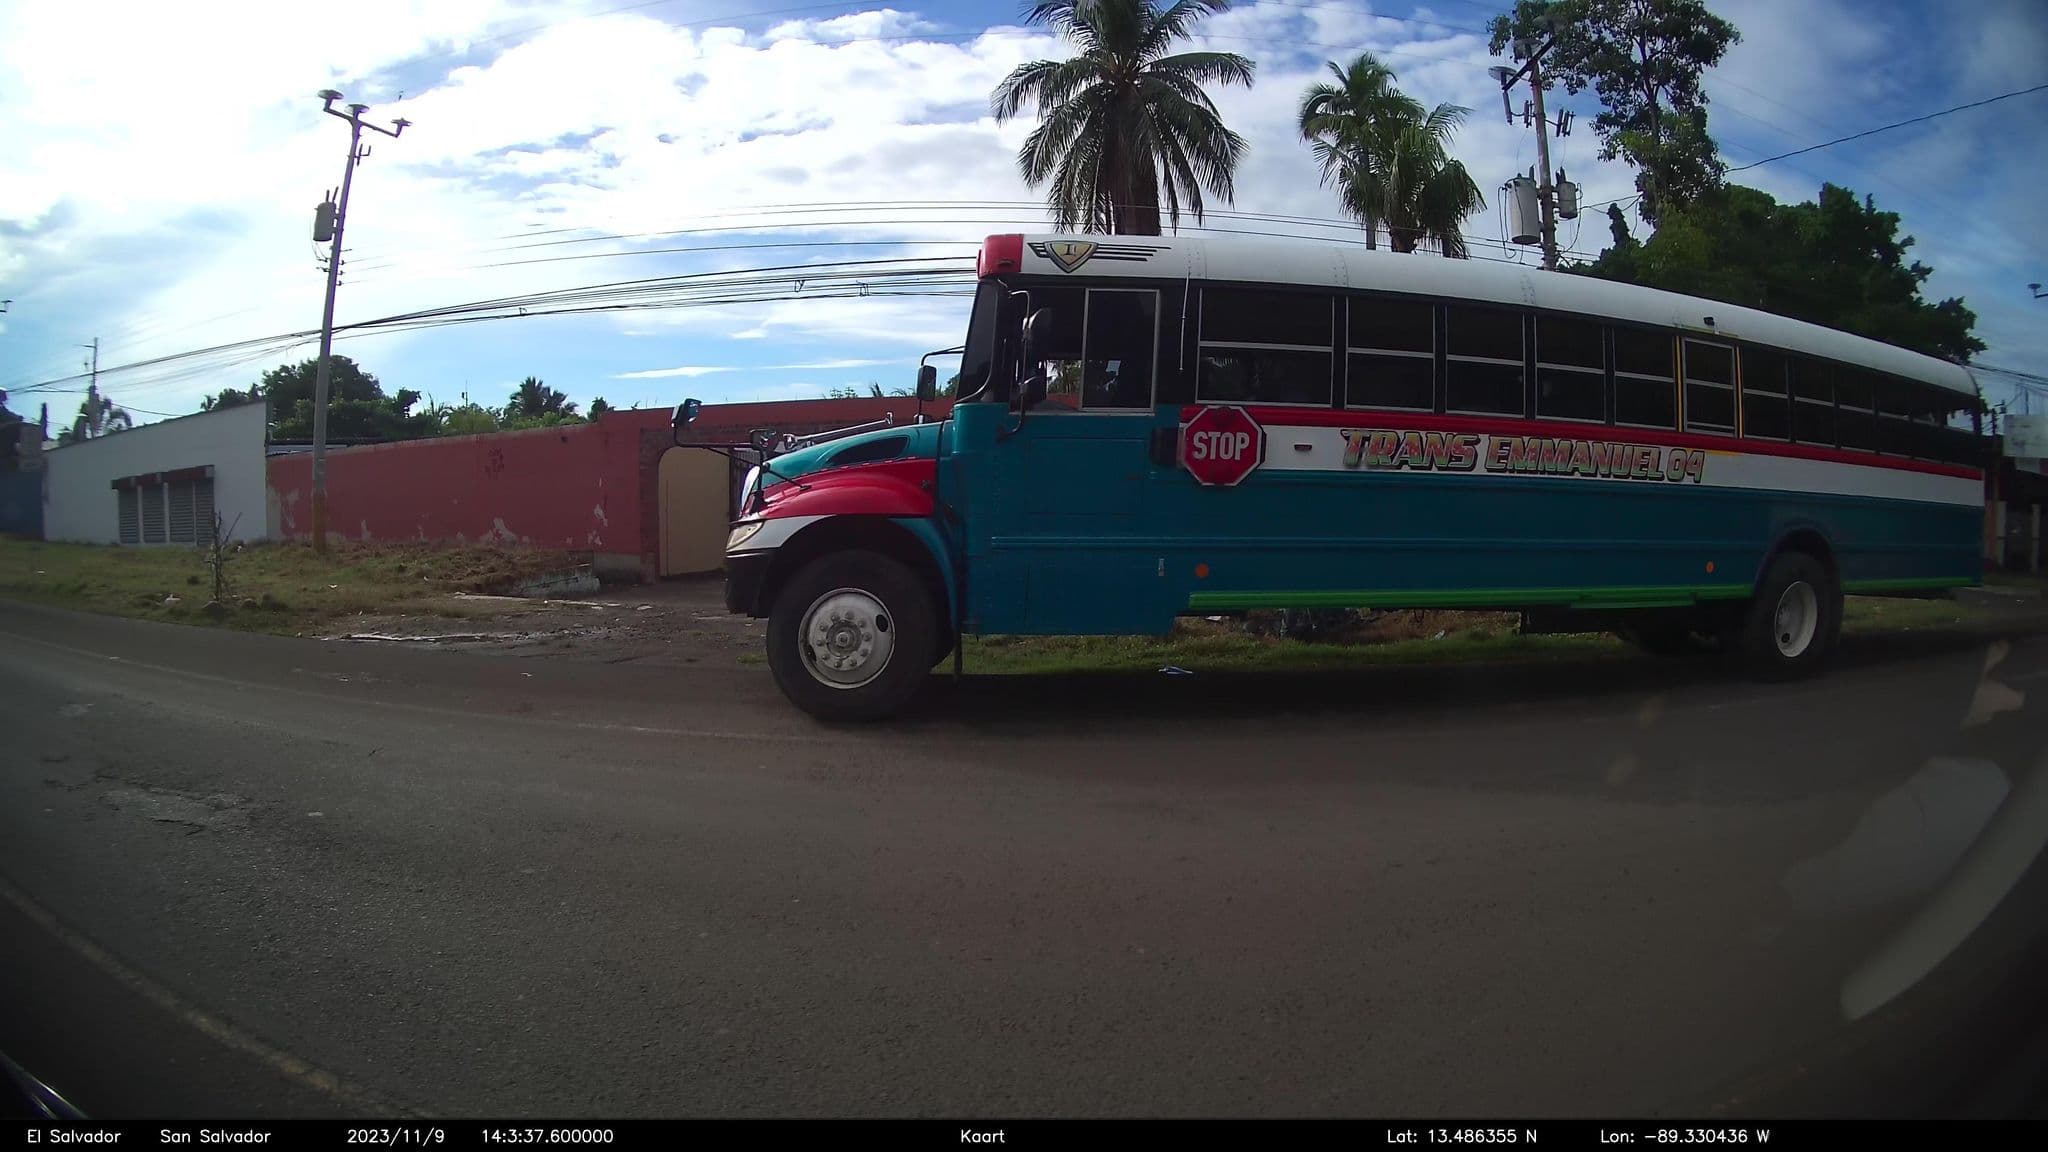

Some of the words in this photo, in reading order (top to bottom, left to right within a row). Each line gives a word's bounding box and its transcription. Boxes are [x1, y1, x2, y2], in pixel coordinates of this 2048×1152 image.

[1193, 431, 1250, 461] STOP
[1340, 429, 1481, 471] TRANS
[1484, 435, 1664, 481] EMMANUEL
